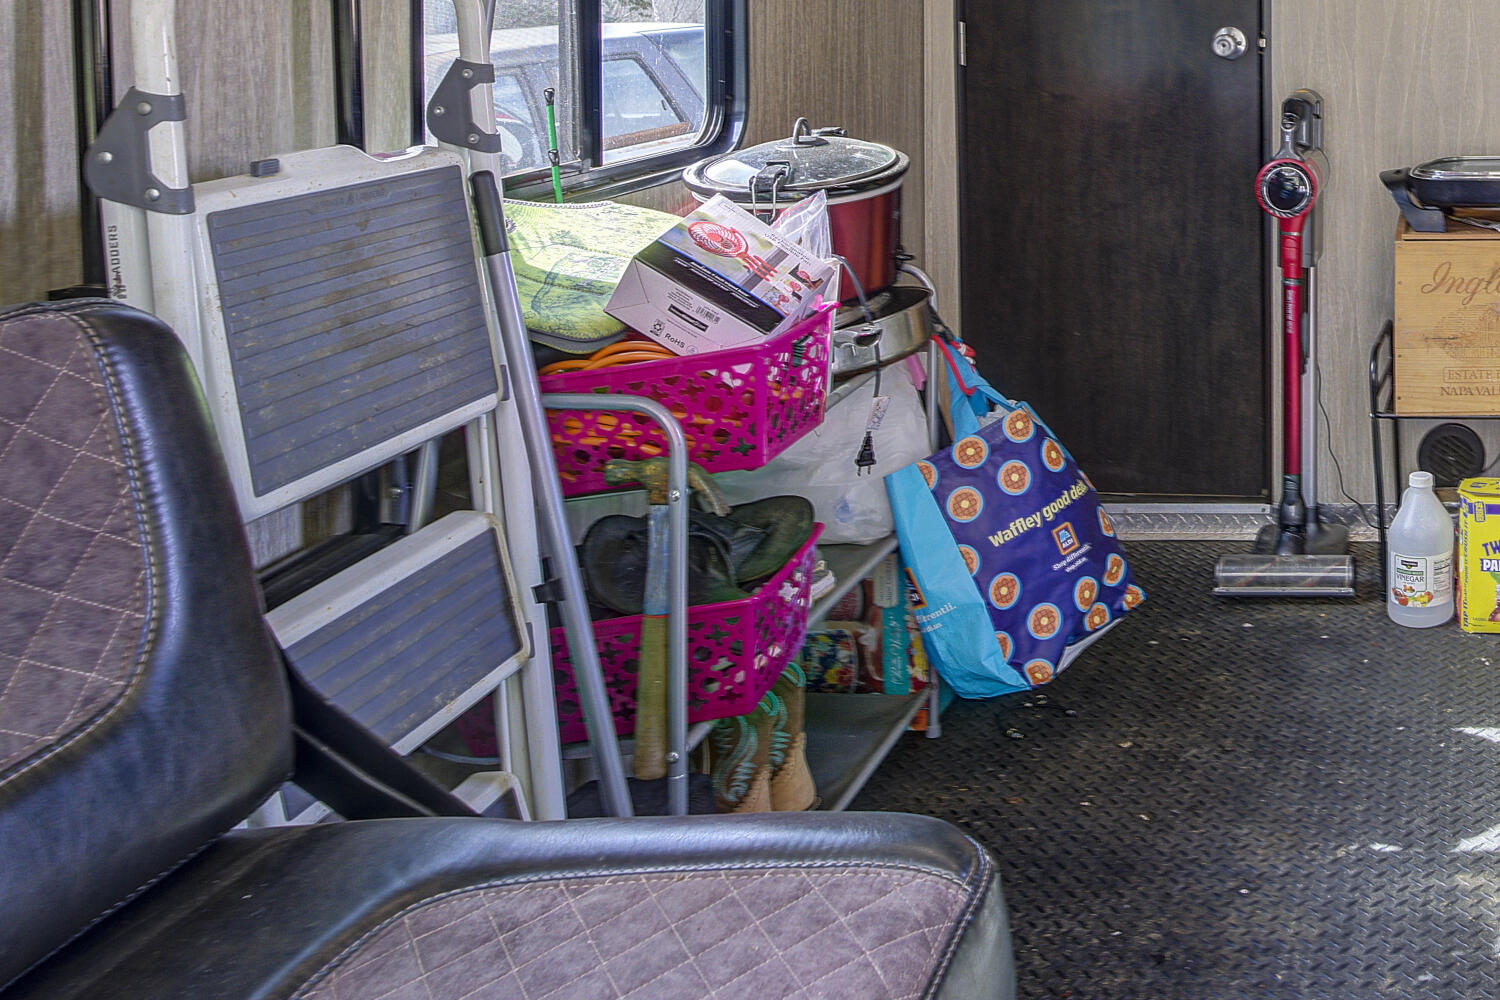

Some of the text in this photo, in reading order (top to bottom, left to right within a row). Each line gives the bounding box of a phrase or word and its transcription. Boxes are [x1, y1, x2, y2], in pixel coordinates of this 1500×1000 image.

[664, 333, 686, 349] RoHS
[1447, 370, 1492, 380] ESTATE
[1440, 386, 1474, 397] NAPA
[988, 512, 1042, 548] Waffley
[1042, 490, 1071, 521] good
[1396, 573, 1425, 583] VINEGAR
